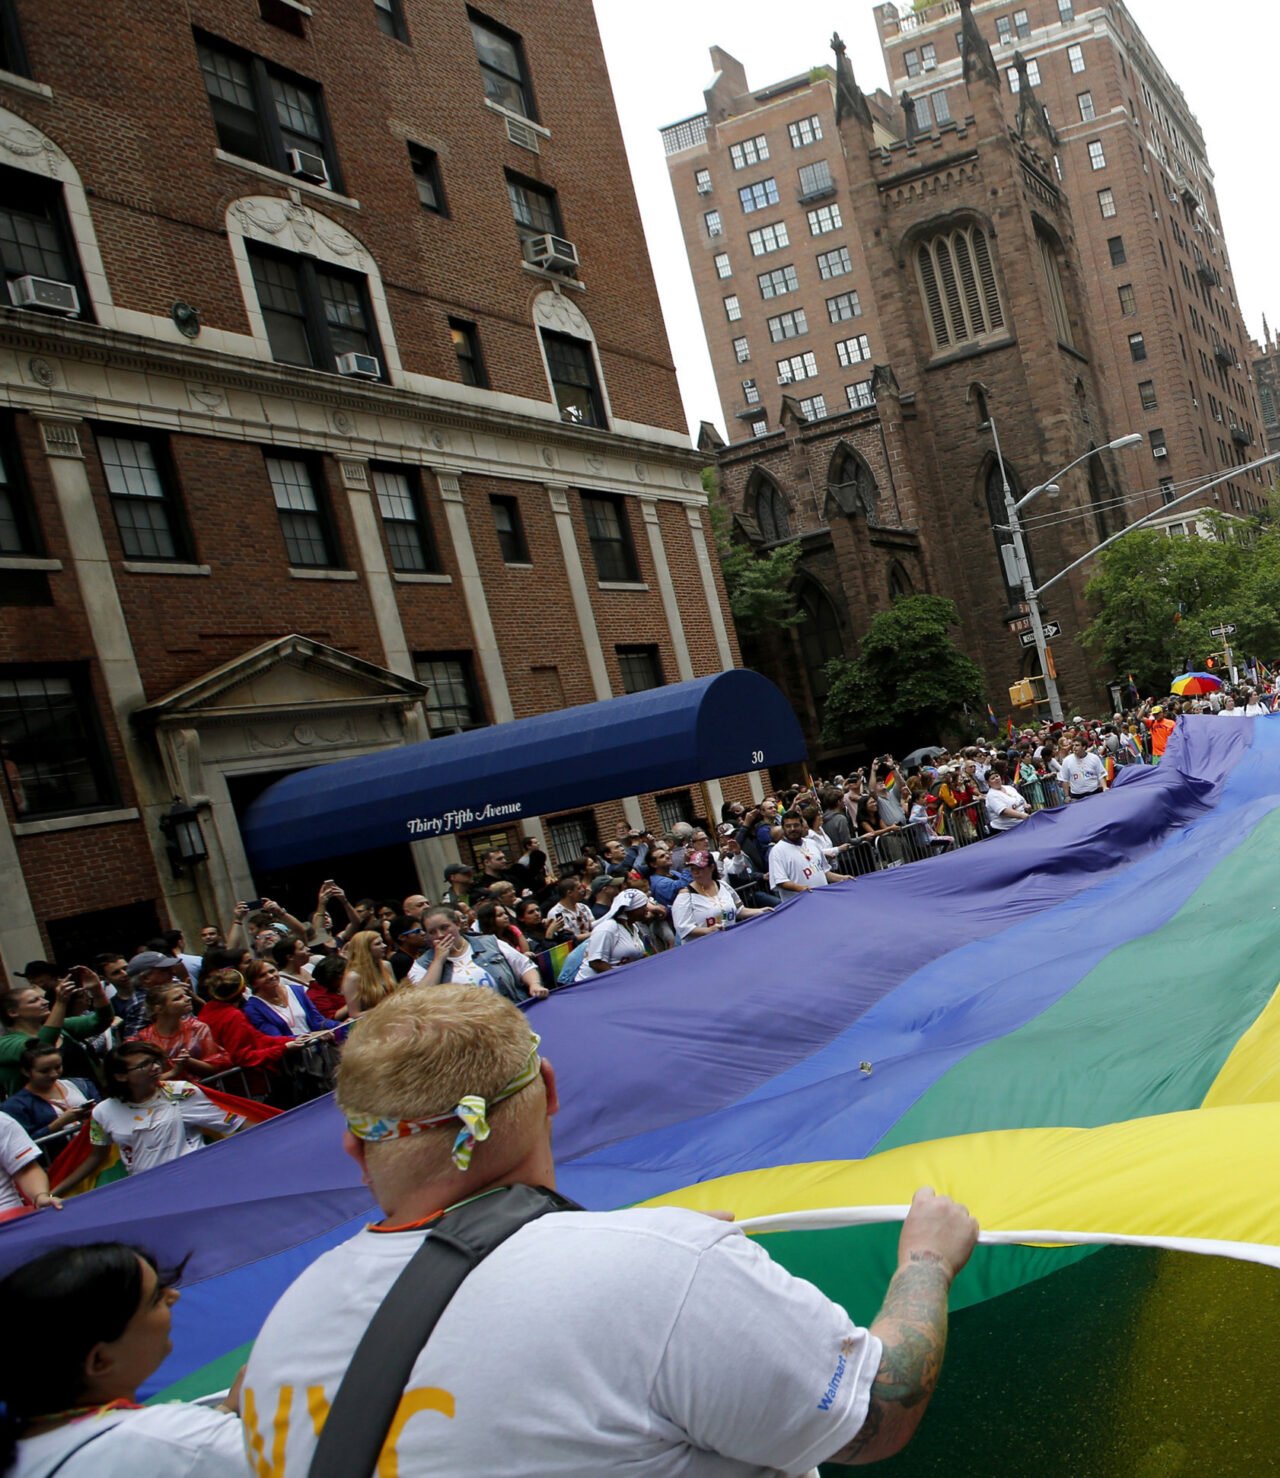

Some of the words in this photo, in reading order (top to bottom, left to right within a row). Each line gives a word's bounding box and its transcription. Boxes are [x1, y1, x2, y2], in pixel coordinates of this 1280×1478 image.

[751, 750, 764, 764] 30
[407, 818, 442, 834] Thirty
[443, 809, 474, 831] Fifth
[475, 802, 522, 821] Avenue
[817, 1354, 847, 1411] Walmart
[243, 1385, 455, 1478] NC
